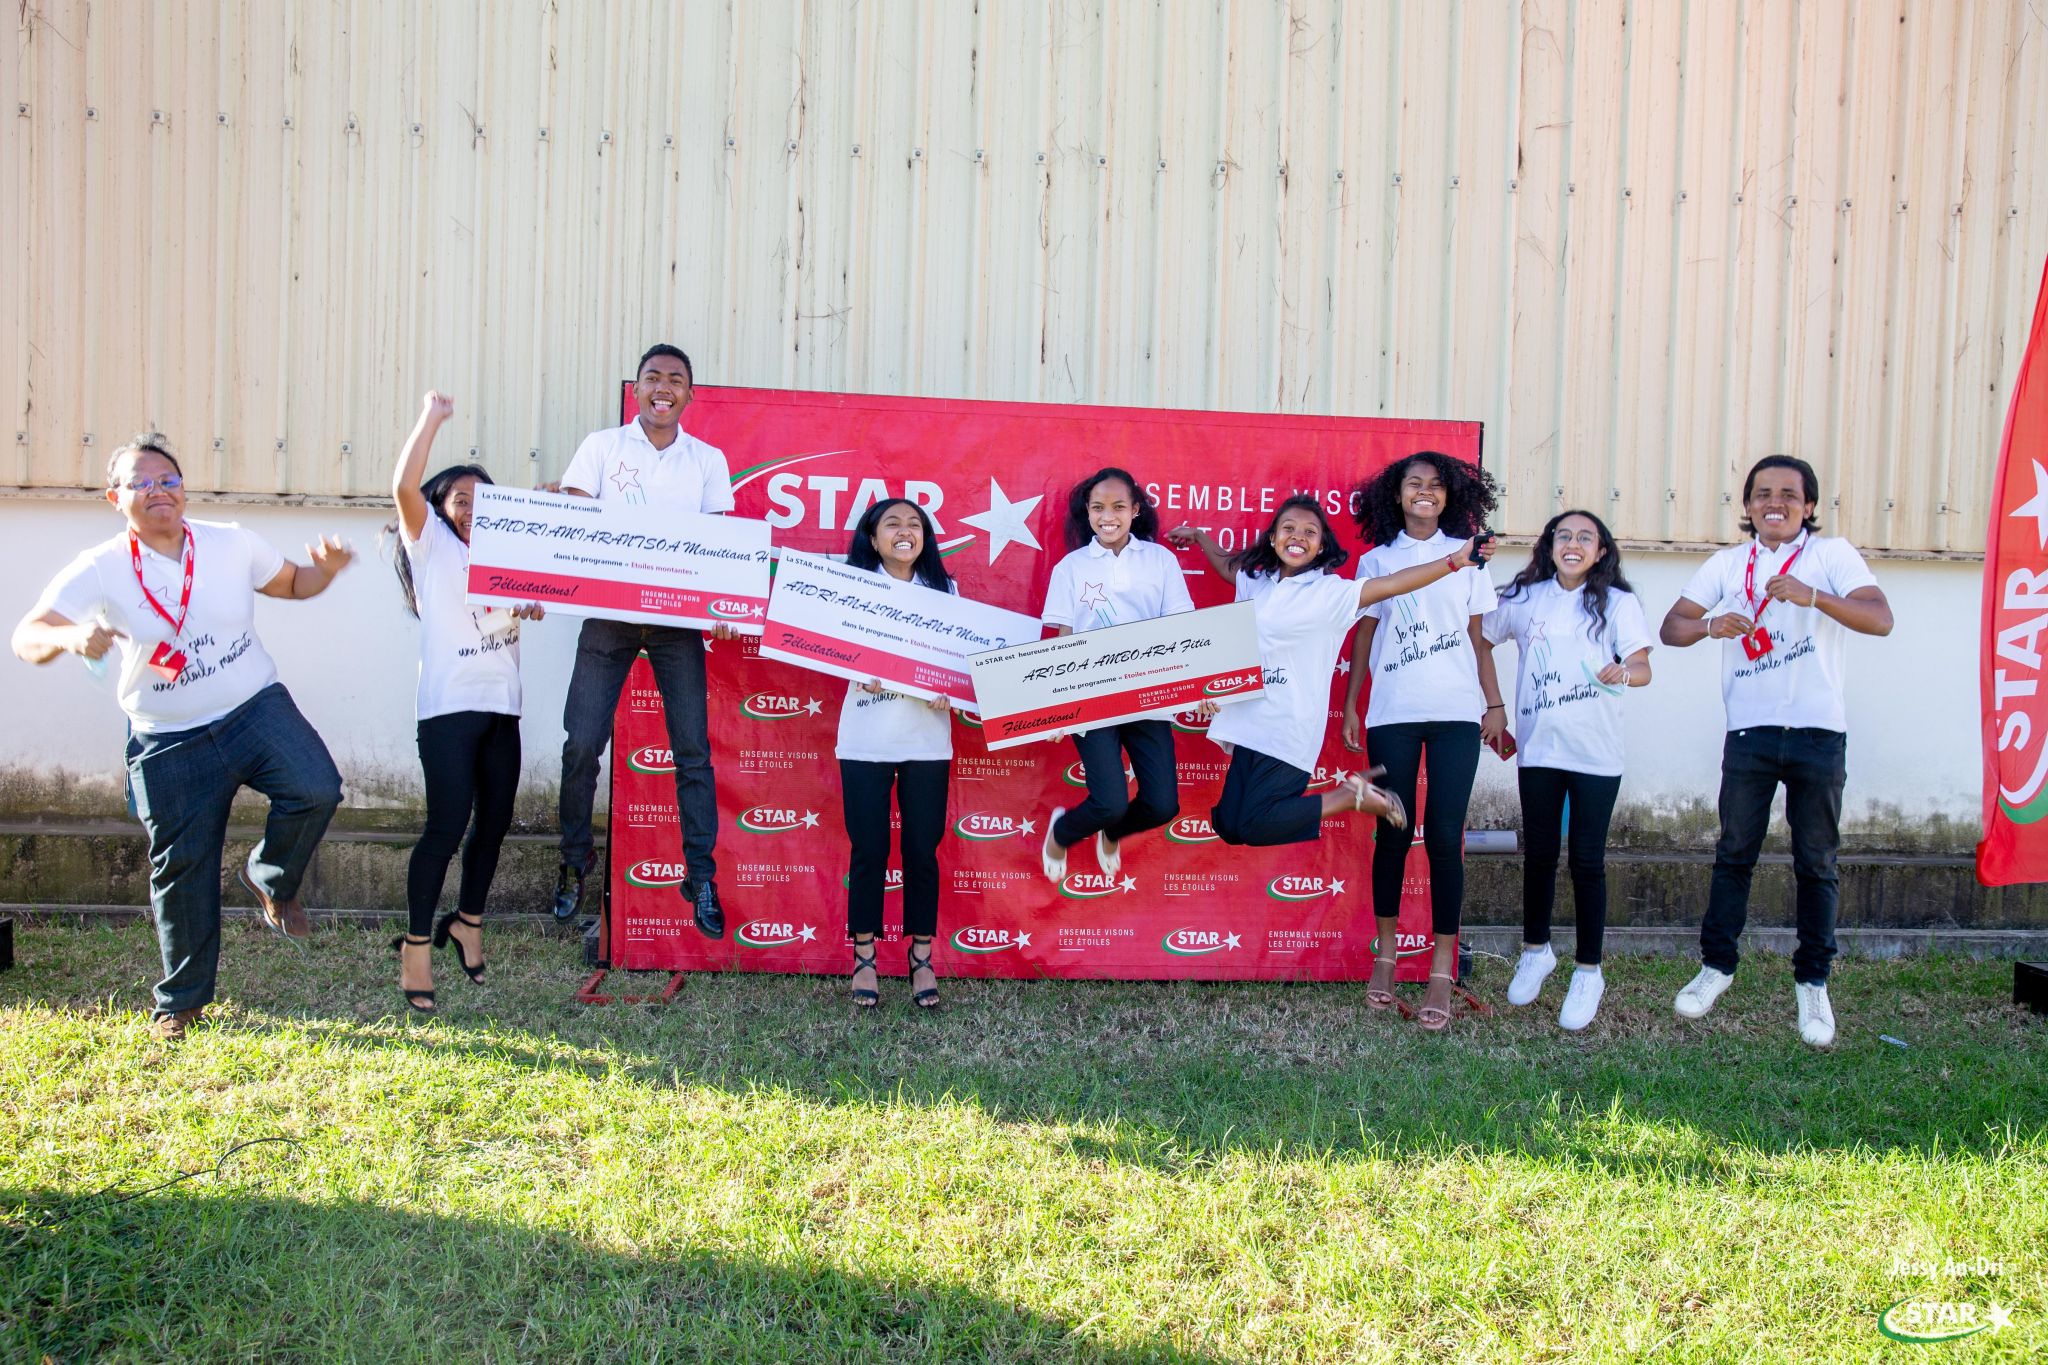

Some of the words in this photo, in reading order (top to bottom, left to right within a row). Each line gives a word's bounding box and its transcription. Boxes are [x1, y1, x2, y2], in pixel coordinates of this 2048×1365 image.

[492, 493, 512, 502] STAR
[529, 498, 561, 509] heureuse
[764, 472, 946, 534] STAR
[1145, 483, 1275, 513] SEMBLE
[475, 516, 681, 553] RANDRIAMIARANTSOA
[683, 541, 751, 562] Mamitiana
[553, 552, 571, 561] dans
[572, 554, 579, 562] le
[581, 556, 623, 567] programme
[631, 561, 654, 571] Etoiles
[656, 565, 692, 576] montantes
[786, 555, 794, 563] La
[795, 558, 813, 569] STAR
[814, 564, 824, 572] est
[827, 567, 856, 581] heureuse
[489, 575, 580, 597] Félicitations!
[640, 597, 653, 605] LES
[641, 590, 675, 600] ENSEMBLE
[677, 594, 701, 603] VISONS
[719, 600, 749, 614] STAR
[842, 620, 857, 629] dans
[866, 628, 903, 642] programme
[910, 639, 931, 651] Etoiles
[932, 645, 965, 660] montantes
[956, 627, 990, 647] Miora
[458, 647, 478, 657] une
[781, 633, 860, 663] Félicitations!
[985, 656, 1004, 665] STAR
[1004, 654, 1015, 662] est
[1018, 647, 1049, 658] heureuse
[1022, 658, 1090, 683] ARISOA
[1093, 642, 1176, 669] AMBOARA
[1179, 638, 1212, 654] Fitia
[1995, 568, 2048, 751] STAR
[1384, 662, 1399, 673] une
[1734, 669, 1753, 678] une
[1052, 685, 1068, 694] dans
[1077, 677, 1117, 690] programme
[1124, 671, 1147, 680] Etoiles
[1148, 664, 1184, 676] montantes
[1262, 666, 1288, 686] tante
[152, 682, 175, 692] une
[1213, 676, 1243, 690] STAR
[631, 689, 662, 698] ENSEM
[1138, 688, 1171, 699] ENSEMBLE
[1172, 683, 1195, 693] VISONS
[631, 699, 647, 707] LES
[756, 695, 800, 711] STAR
[1139, 696, 1151, 705] LES
[1002, 707, 1081, 736] Félicitations!
[643, 749, 674, 763] STA
[740, 751, 784, 759] ENSEMBLE
[787, 752, 819, 760] VISONS
[740, 760, 755, 768] LES
[759, 759, 793, 769] ÉTOILES
[957, 758, 1001, 766] ENSEMBLE
[1005, 759, 1036, 767] VISONS
[957, 767, 973, 775] LES
[976, 766, 1011, 776] ÉTOILES
[1186, 772, 1220, 780] ÉTOILES
[628, 804, 673, 812] ENSEMBLE
[628, 814, 644, 822] LES
[753, 809, 797, 823] STAR
[970, 815, 1014, 831] STAR
[1180, 820, 1215, 833] STA
[1321, 820, 1345, 828] ISONS
[641, 863, 685, 878] STAR
[737, 864, 781, 872] ENSEMBLE
[784, 865, 815, 873] VISONS
[737, 873, 752, 882] LES
[756, 873, 790, 883] ÉTOILES
[954, 871, 998, 879] ENSEMBLE
[1001, 872, 1031, 880] VISONS
[1074, 874, 1115, 888] STAR
[1165, 874, 1207, 882] ENSEMBLE
[1209, 874, 1239, 882] VISONS
[953, 880, 969, 888] LES
[972, 879, 1007, 889] ÉTOILES
[1164, 883, 1180, 891] LES
[1182, 882, 1216, 892] ÉTOILES
[1282, 876, 1323, 891] STAR
[626, 918, 671, 926] ENSEMBLE
[675, 919, 697, 927] VISO
[627, 928, 643, 936] LES
[646, 927, 681, 936] ÉTOILES
[751, 923, 794, 937] STAR
[967, 929, 1010, 944] STAR
[1059, 928, 1102, 936] ENSEMBLE
[1104, 928, 1134, 936] VISONS
[1269, 930, 1311, 939] ENSEMBLE
[1314, 931, 1343, 939] VISONS
[1059, 938, 1074, 946] LES
[1077, 937, 1111, 946] ÉTOILES
[1177, 931, 1219, 945] STAR
[1268, 940, 1283, 948] LES
[1286, 939, 1320, 948] ÉTOILES
[1395, 934, 1427, 948] TAR
